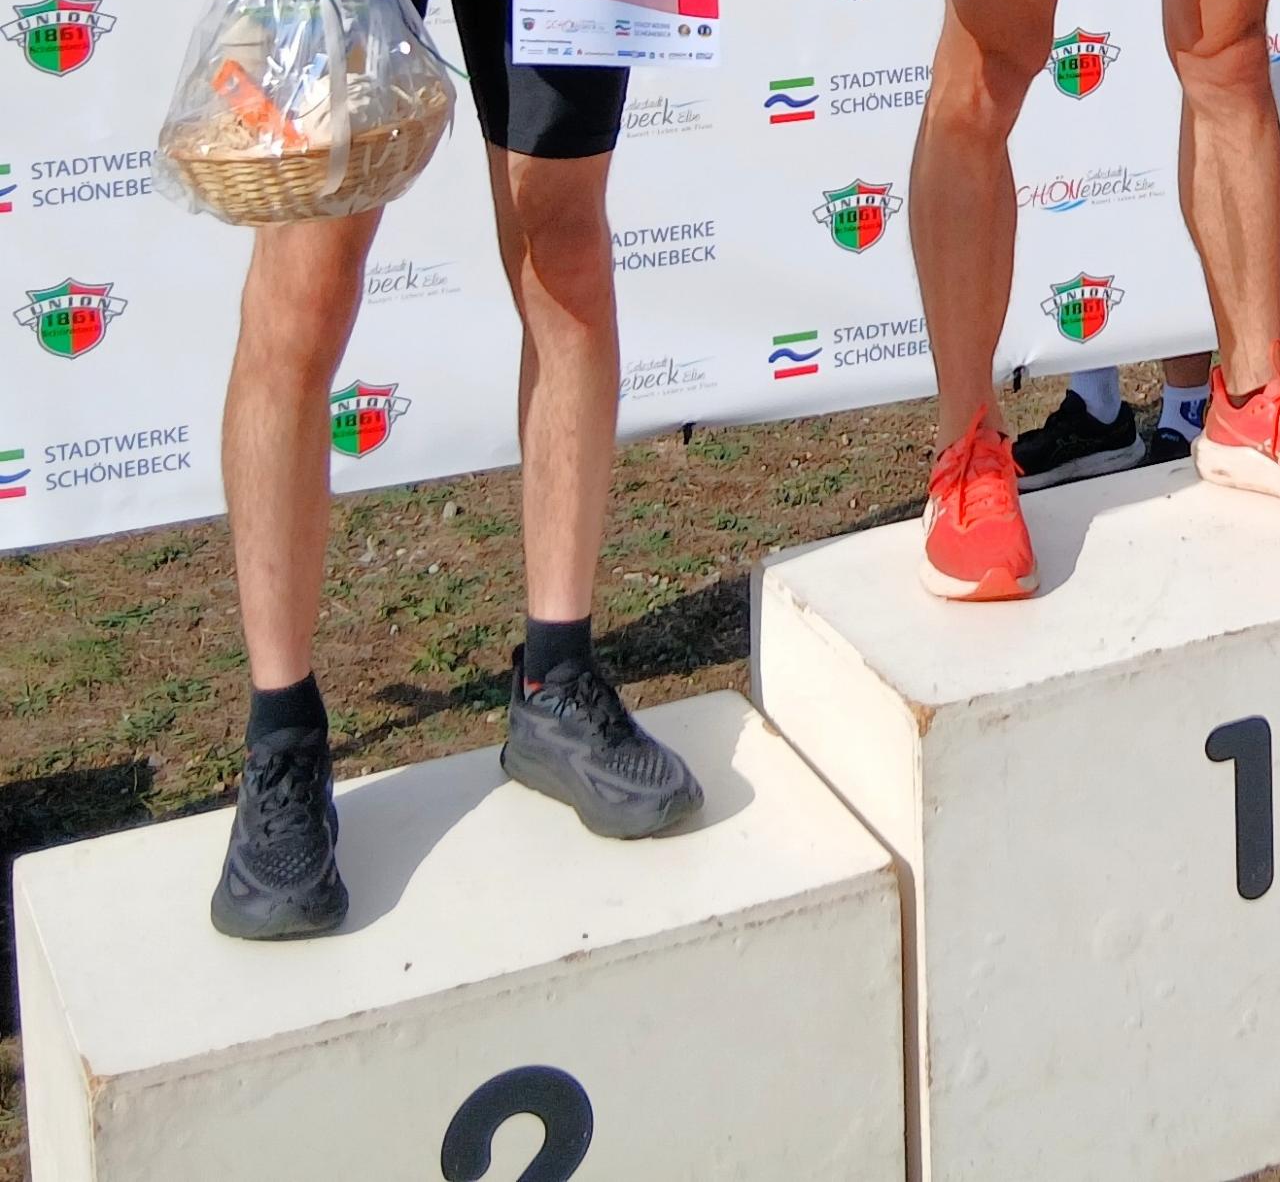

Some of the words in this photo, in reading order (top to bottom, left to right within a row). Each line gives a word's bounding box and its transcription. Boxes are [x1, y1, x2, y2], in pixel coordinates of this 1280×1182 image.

[17, 11, 101, 31] UNION
[34, 25, 84, 43] 1861
[1051, 44, 1109, 60] UNION
[1057, 57, 1099, 71] 1861
[31, 150, 156, 180] STADTWER
[33, 175, 152, 207] SCHÖNEBE
[1016, 168, 1132, 208] CHÖNebeck
[826, 197, 890, 214] UNION
[612, 220, 716, 247] ADTWERKE
[614, 244, 717, 271] HÖNEBECK
[31, 295, 111, 317] UNION
[1053, 287, 1112, 304] UNION
[45, 309, 96, 327] 1861
[835, 337, 931, 368] SCHÖNEBE
[620, 359, 679, 392] ebeck
[337, 397, 399, 413] NION
[44, 425, 189, 463] STADTWERKE
[46, 449, 191, 490] SCHÖNEBECK
[1204, 714, 1274, 901] 1
